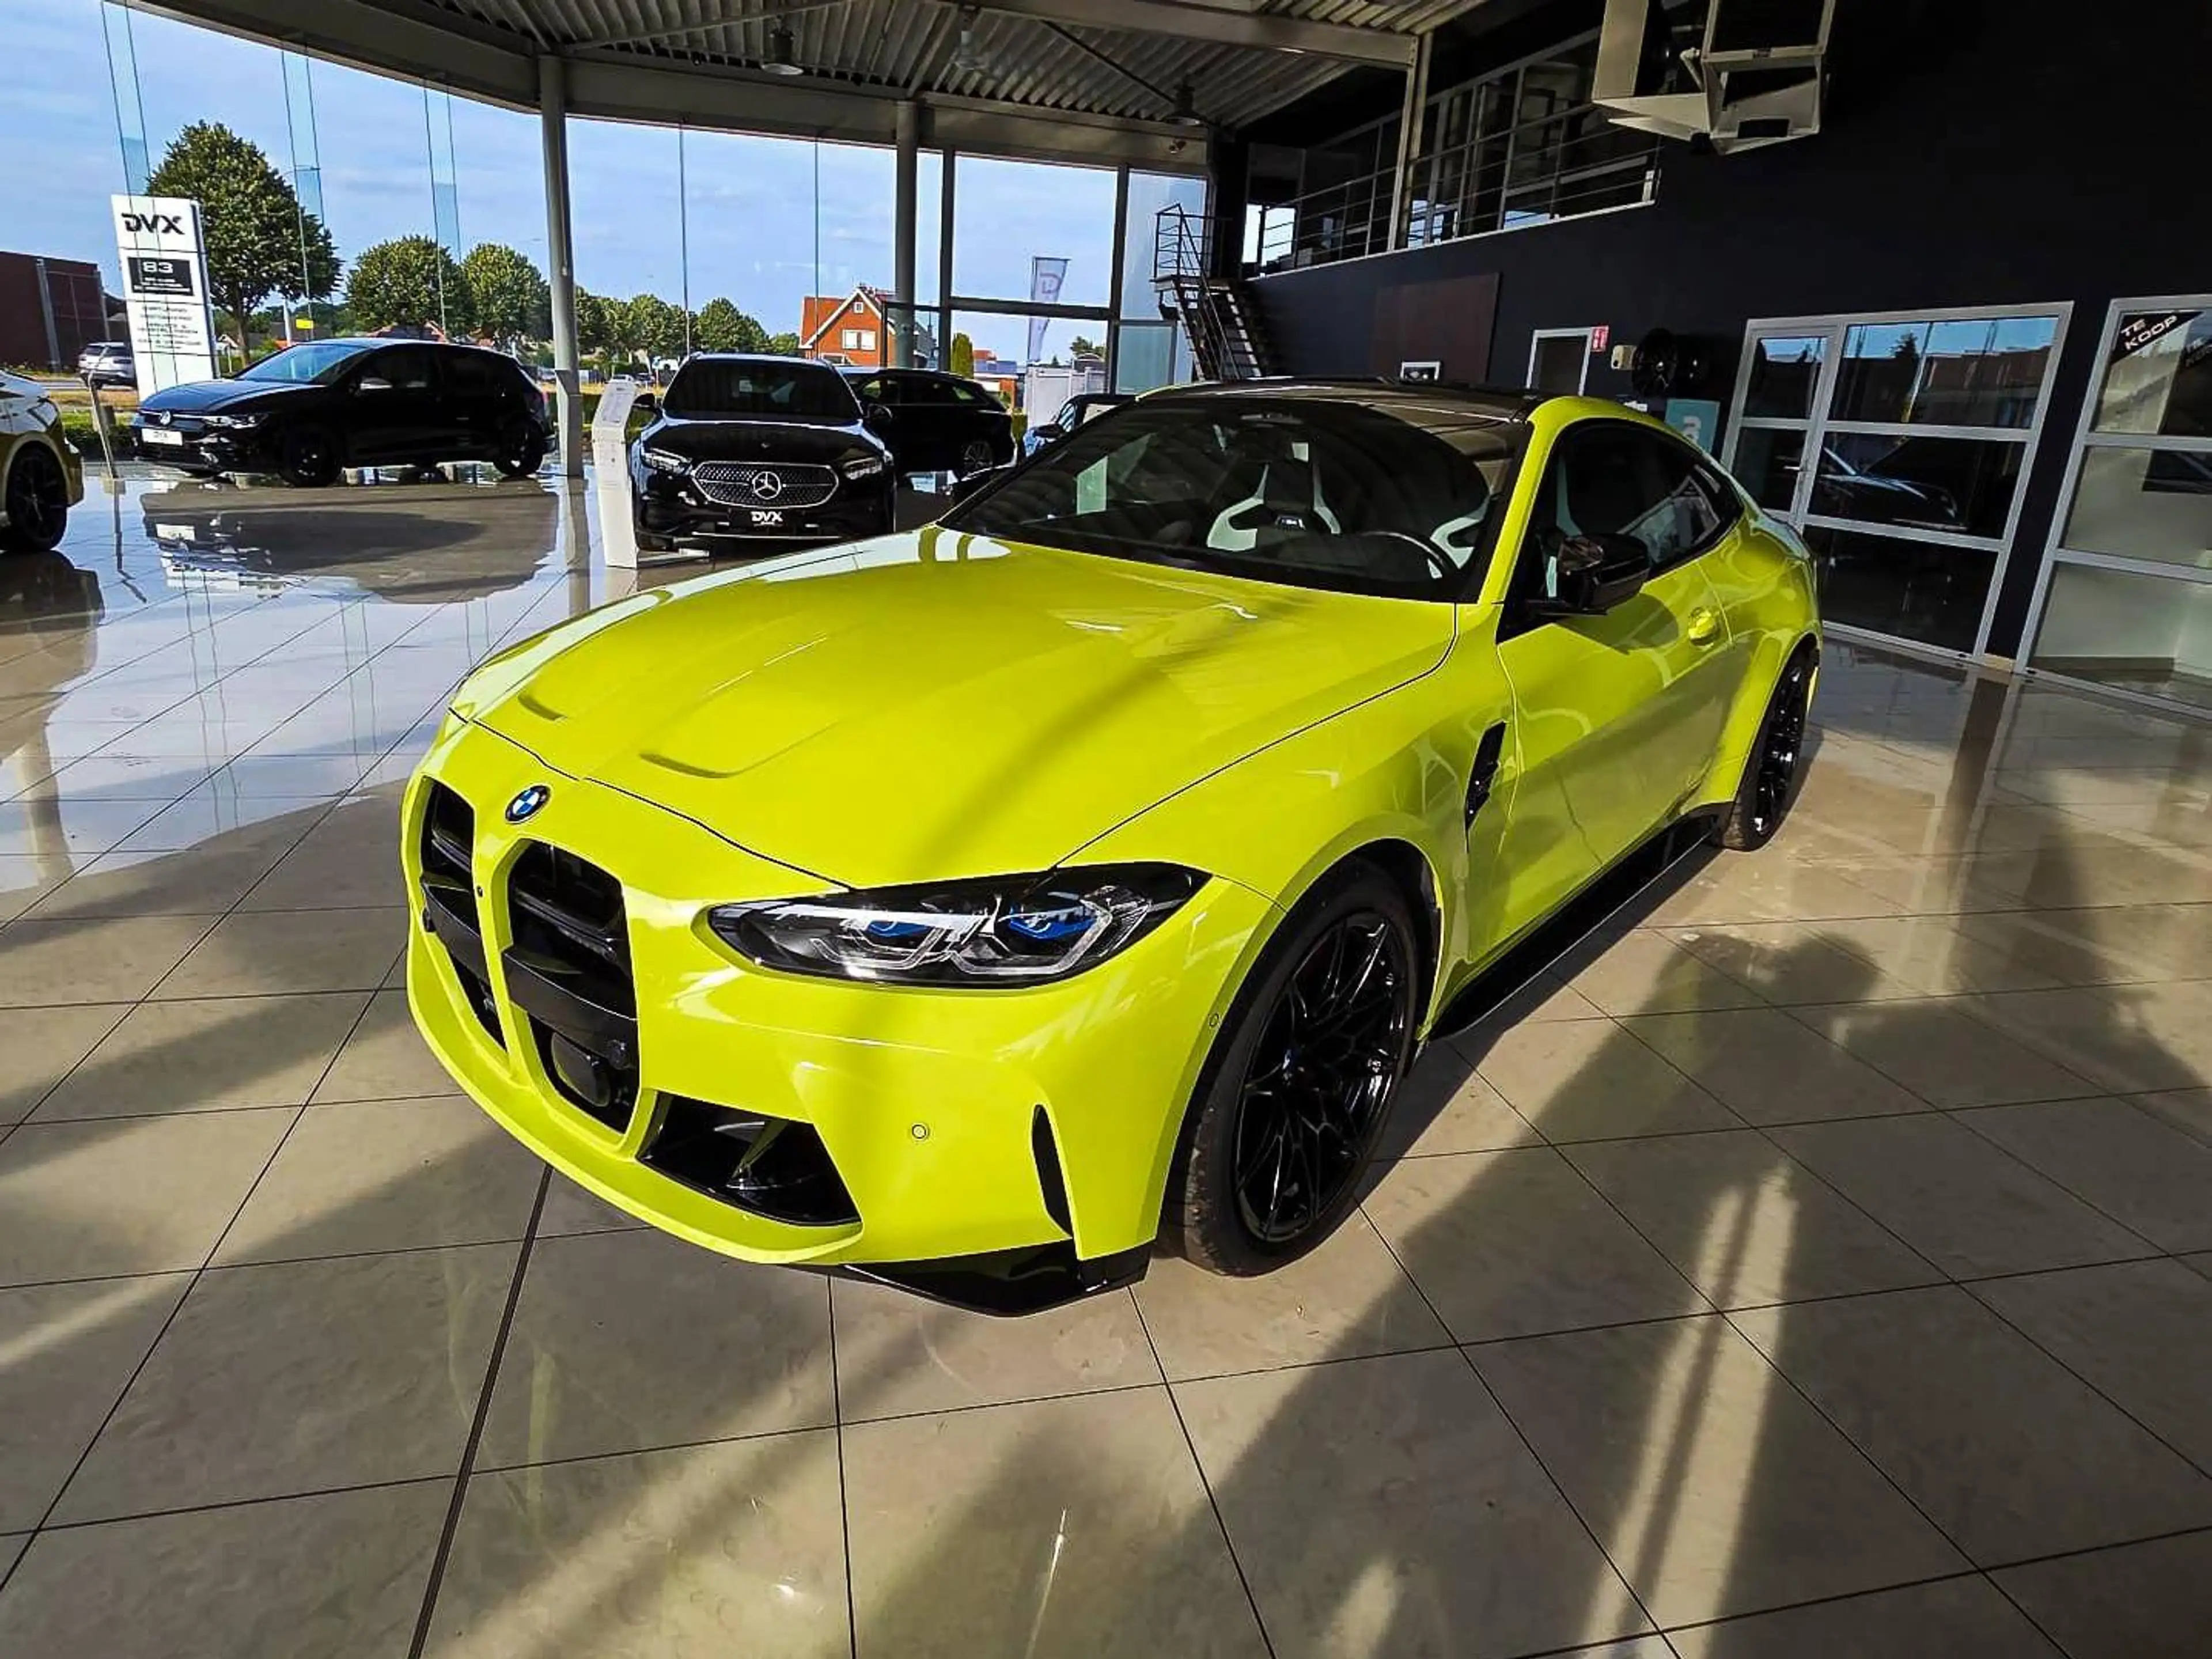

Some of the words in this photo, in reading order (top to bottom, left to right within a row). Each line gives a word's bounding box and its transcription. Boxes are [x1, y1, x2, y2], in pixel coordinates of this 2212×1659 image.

[121, 213, 185, 235] DVX
[2121, 318, 2146, 336] TE
[2124, 315, 2177, 350] KOOP
[751, 511, 783, 522] DVX
